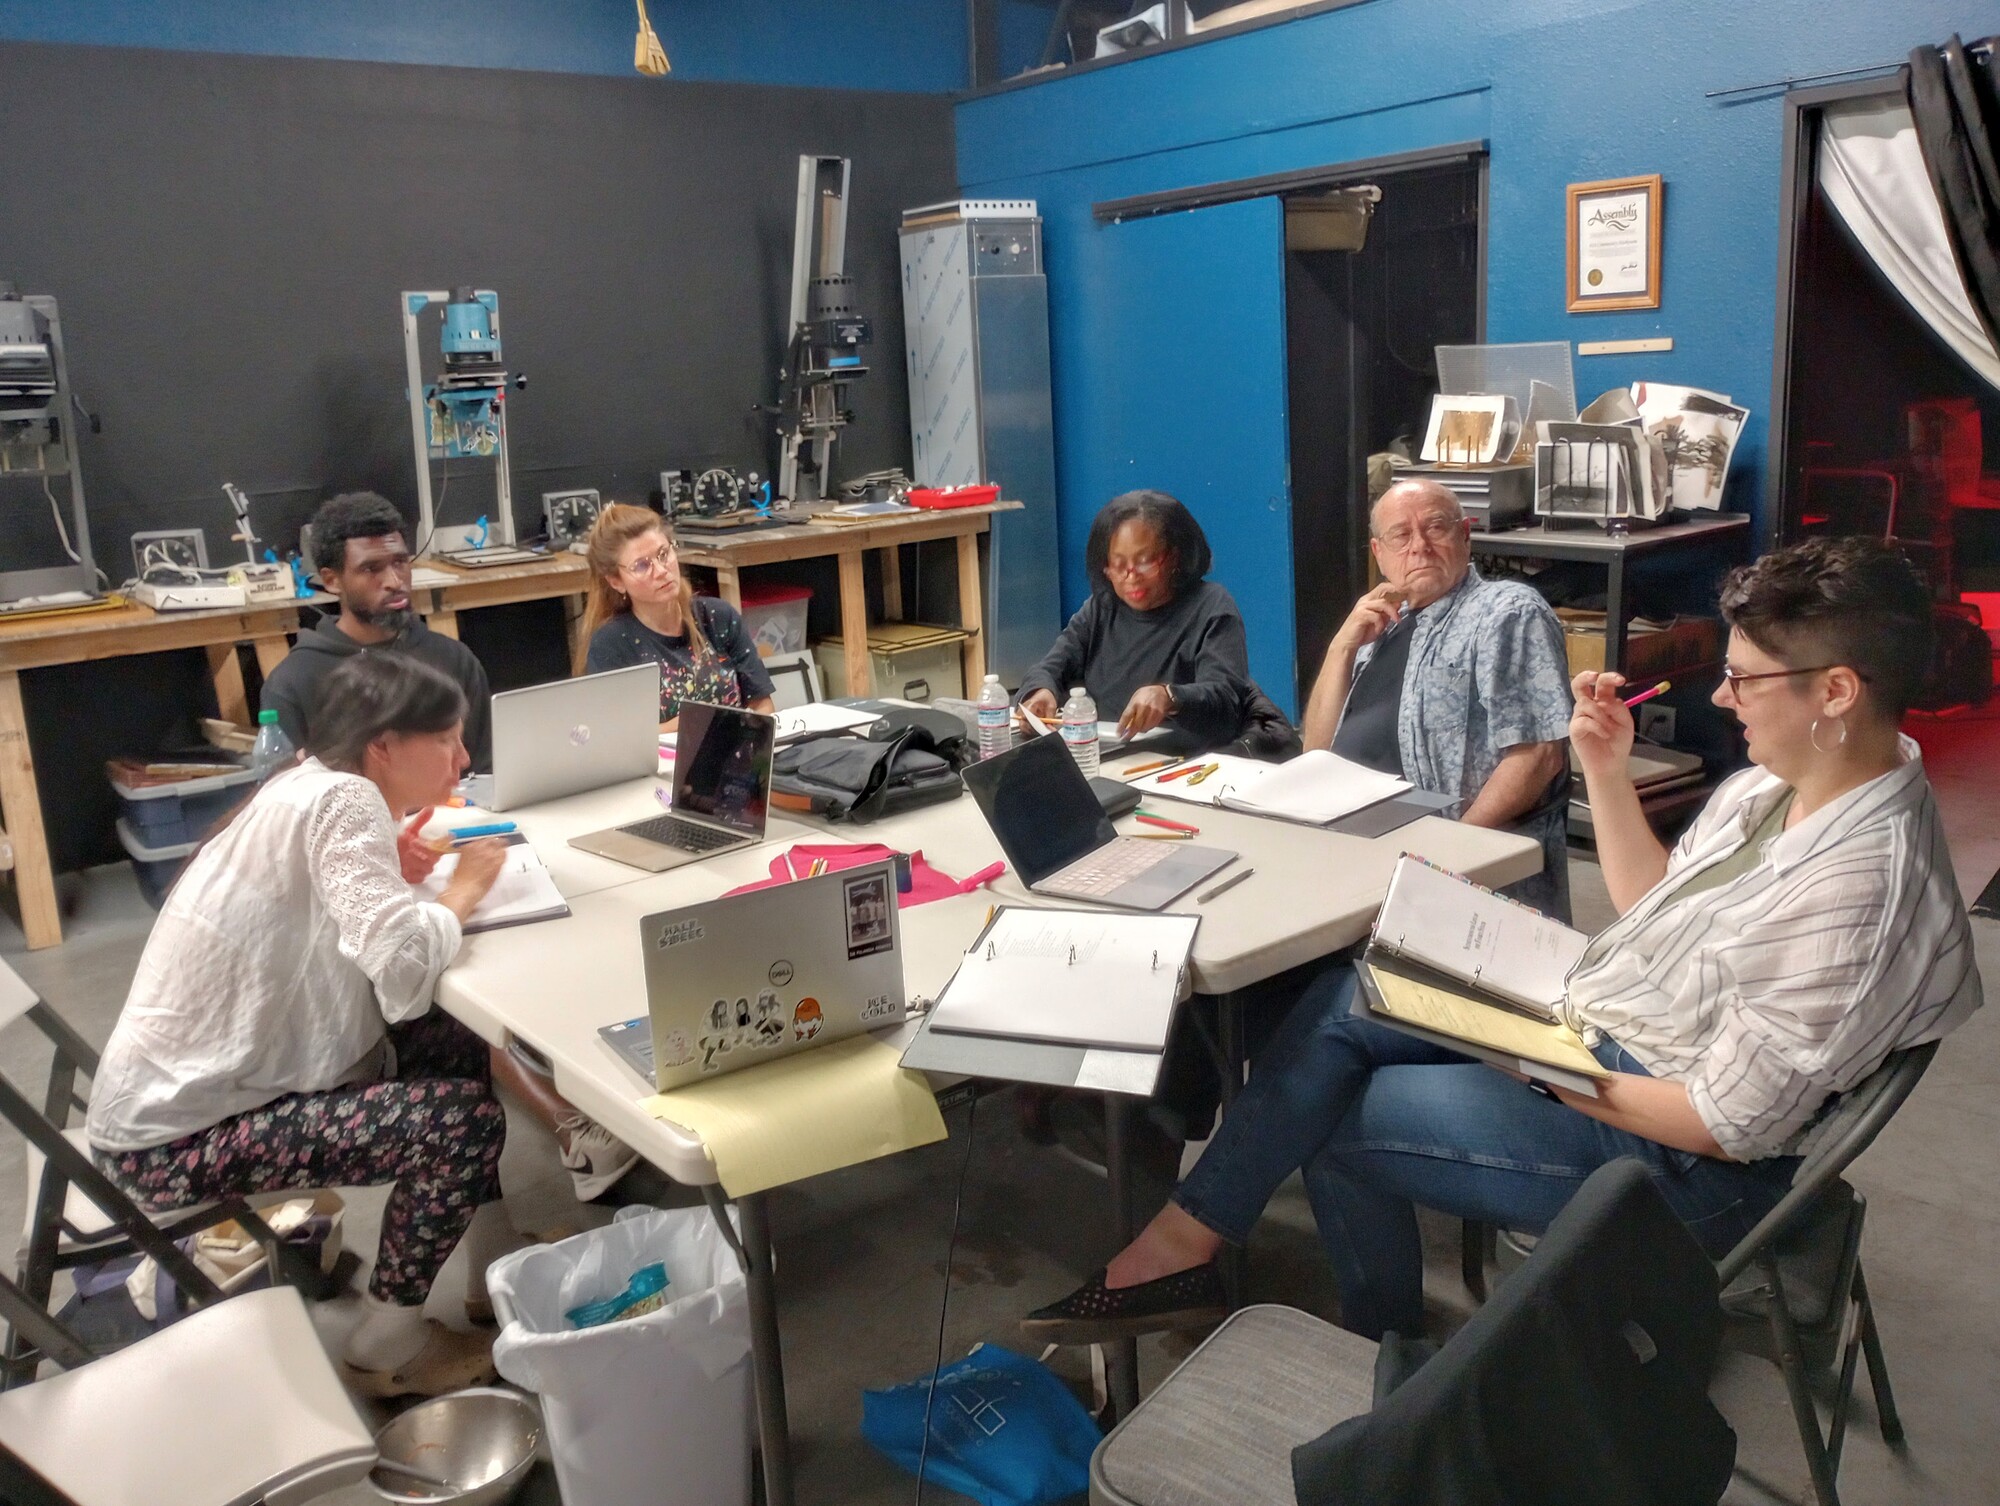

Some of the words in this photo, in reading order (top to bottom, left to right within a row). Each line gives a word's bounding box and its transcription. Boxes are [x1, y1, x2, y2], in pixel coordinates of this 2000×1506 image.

[1588, 203, 1637, 226] Assembly
[868, 995, 887, 1008] ICE
[861, 1003, 896, 1020] COLD
